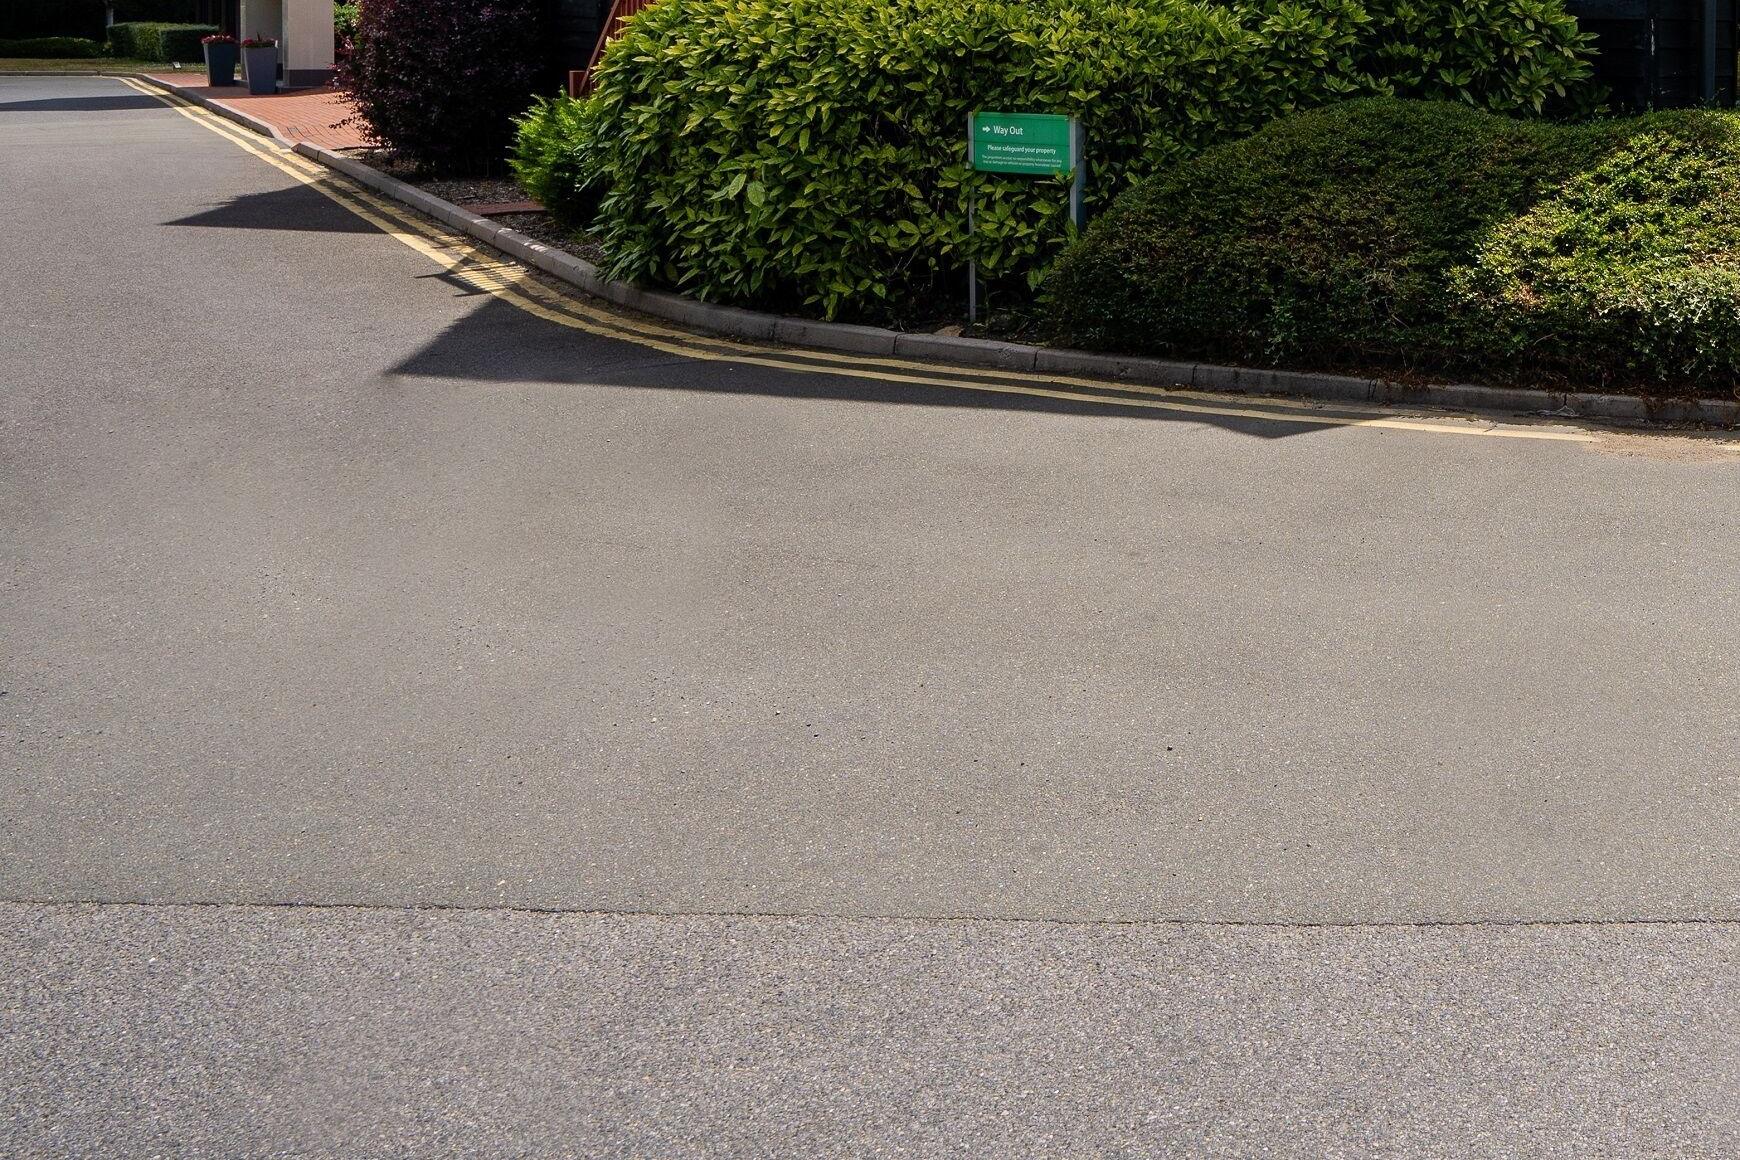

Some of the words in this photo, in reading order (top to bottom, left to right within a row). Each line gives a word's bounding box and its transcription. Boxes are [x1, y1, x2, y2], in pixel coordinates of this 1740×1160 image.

[993, 125, 1009, 136] Way
[1009, 126, 1024, 135] Out
[1002, 145, 1025, 153] safeguard
